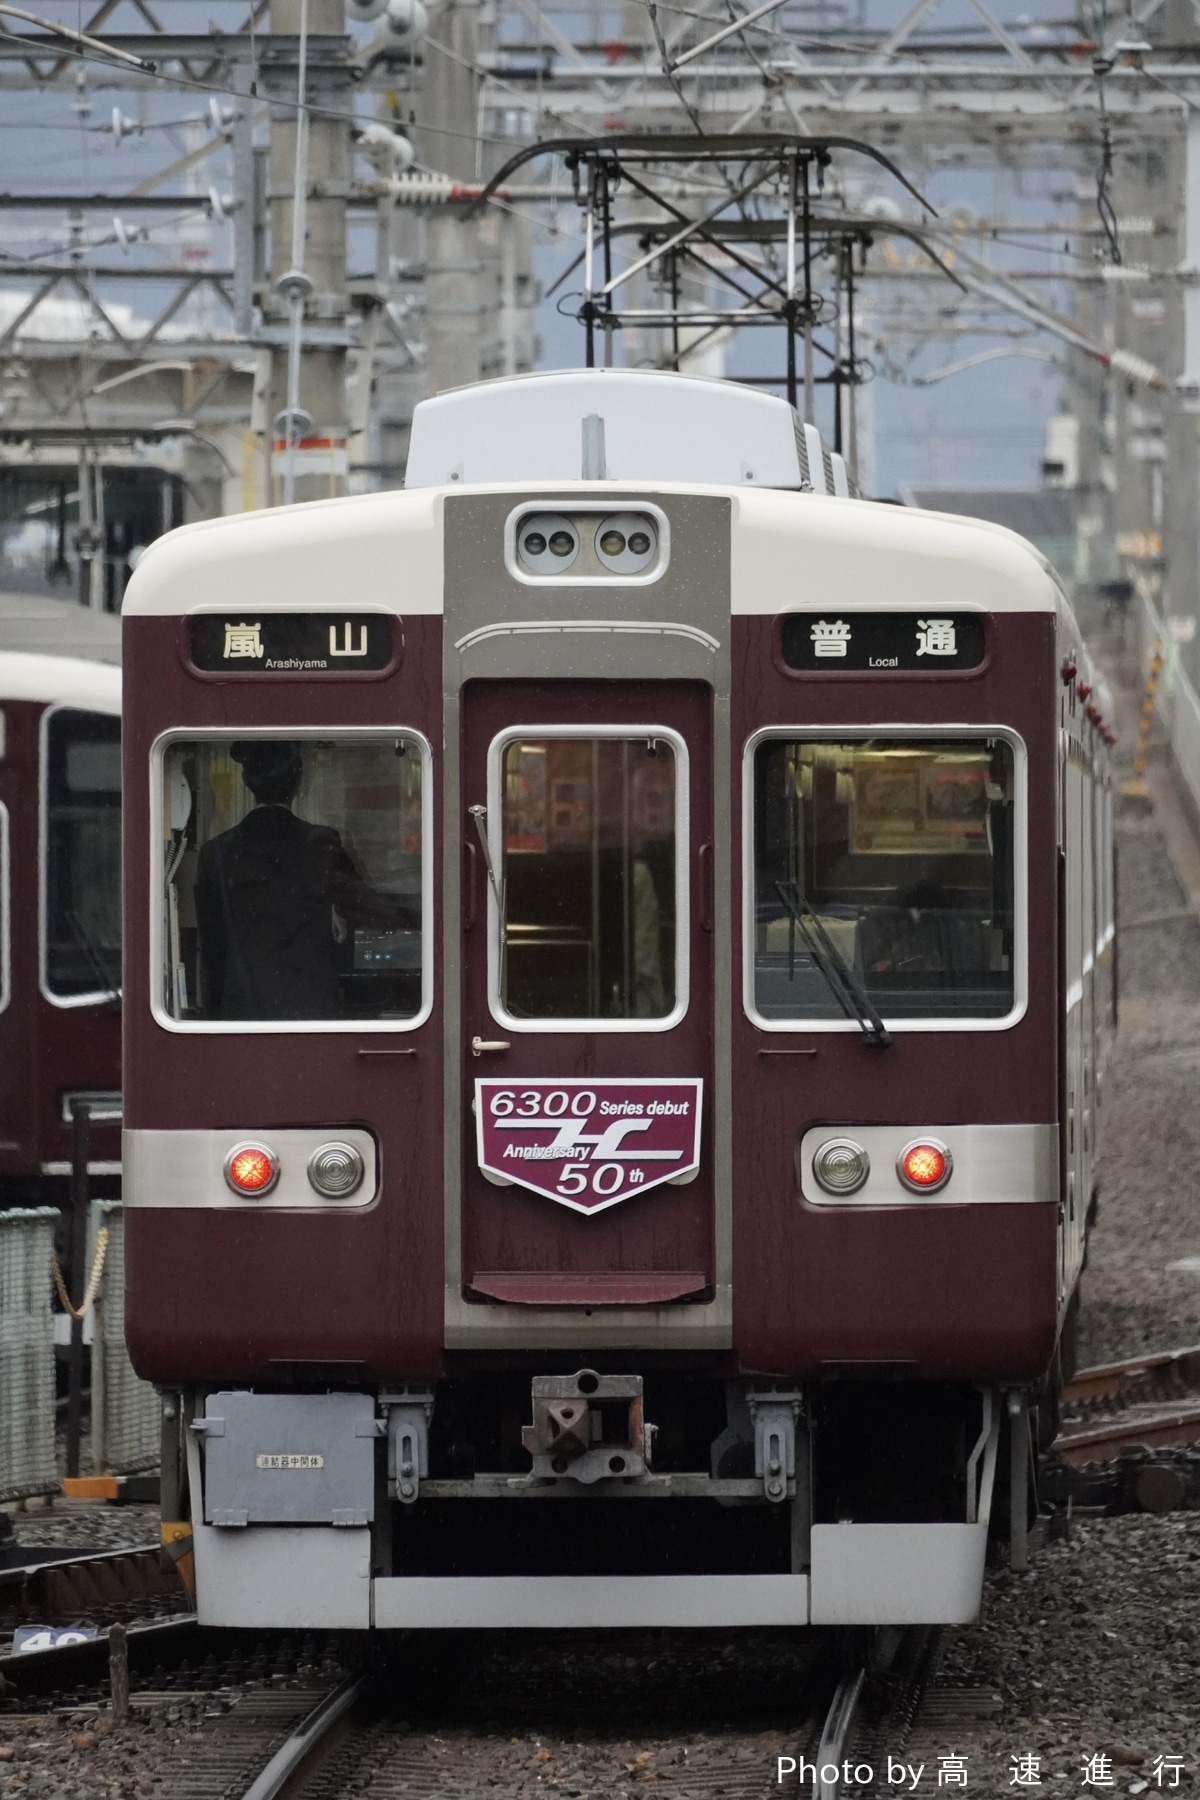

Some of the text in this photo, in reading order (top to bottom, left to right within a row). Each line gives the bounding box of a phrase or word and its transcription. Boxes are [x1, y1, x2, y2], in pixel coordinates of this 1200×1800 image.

[265, 658, 327, 670] Arashiyama
[869, 657, 898, 667] Local
[490, 1091, 689, 1116] 6300 Series debut
[503, 1144, 590, 1161] Anniversary
[556, 1163, 644, 1195] 50 th
